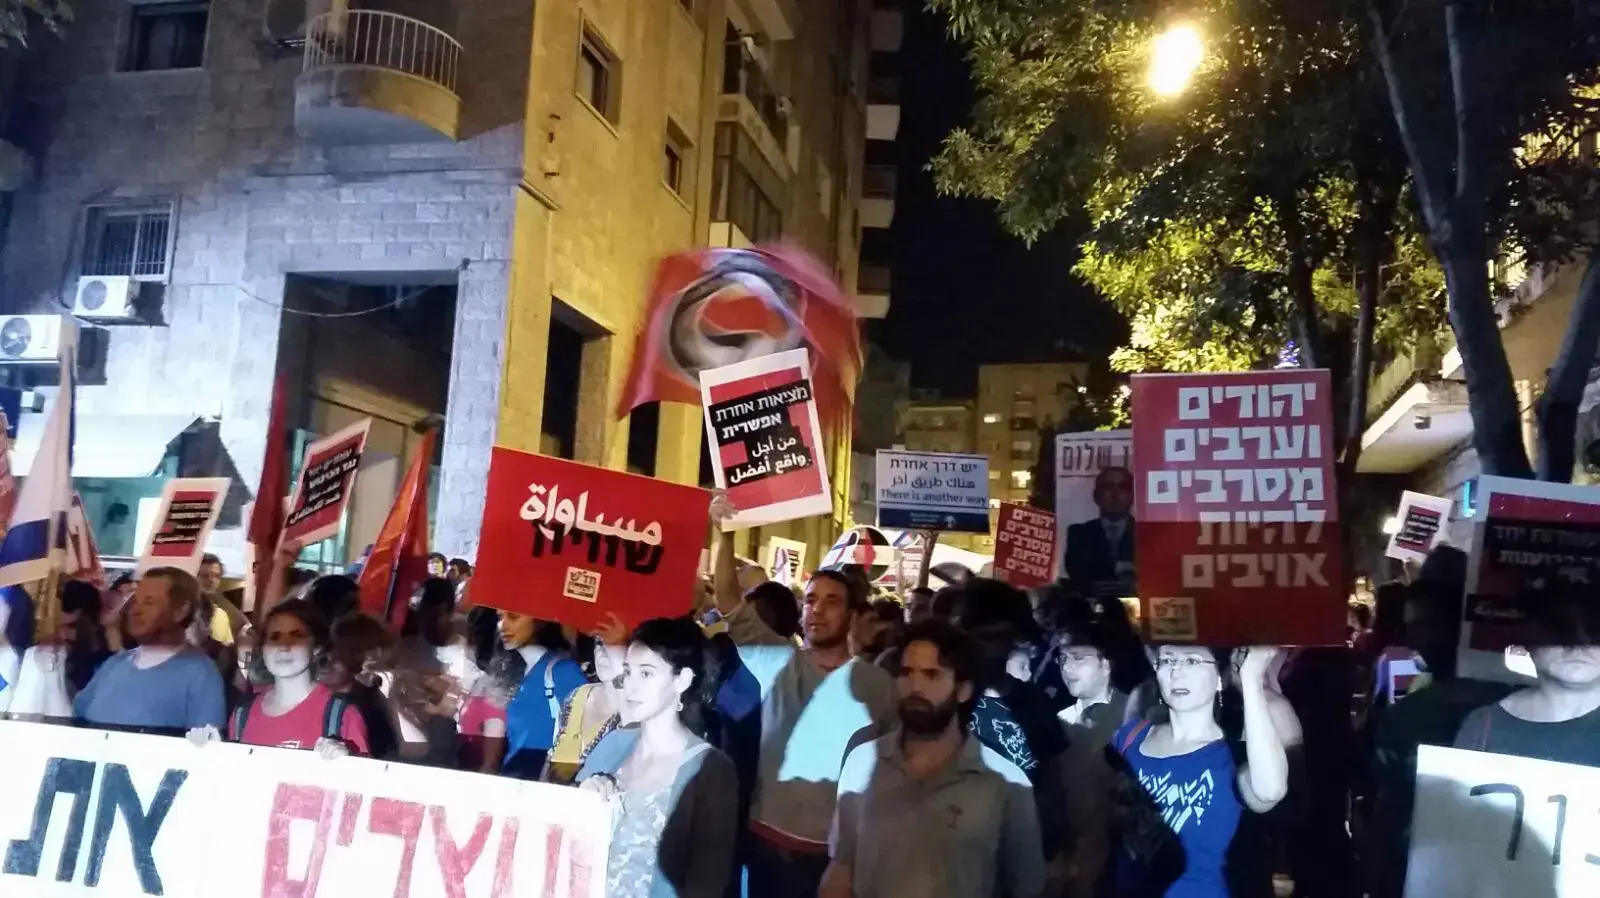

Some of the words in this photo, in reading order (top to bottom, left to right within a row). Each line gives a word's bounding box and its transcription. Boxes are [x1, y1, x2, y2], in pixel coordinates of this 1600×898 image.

[758, 386, 809, 410] מציאות
[1179, 383, 1316, 420] יהודים
[716, 401, 754, 422] אחרת
[722, 413, 782, 439] אפשרית
[752, 435, 773, 457] أجل
[777, 436, 797, 450] من
[1164, 425, 1322, 462] וערבים
[774, 453, 807, 473] واقع
[890, 458, 928, 471] אחרת
[932, 461, 956, 473] דרך
[961, 463, 978, 473] יש
[1063, 443, 1112, 471] שלום
[730, 456, 771, 483] أفضل
[911, 476, 942, 489] طريق
[946, 478, 976, 489] هناك
[1148, 467, 1324, 503] מסרבים
[880, 488, 909, 499] There
[912, 490, 920, 500] is
[923, 492, 963, 503] another
[966, 496, 987, 507] way
[520, 483, 663, 546] مساواة
[1012, 508, 1054, 528] יהודים
[1198, 503, 1326, 545] להיות
[999, 531, 1052, 554] מסרבים
[1182, 553, 1330, 588] אויבים
[2, 756, 190, 896] את
[1469, 783, 1600, 867] ור
